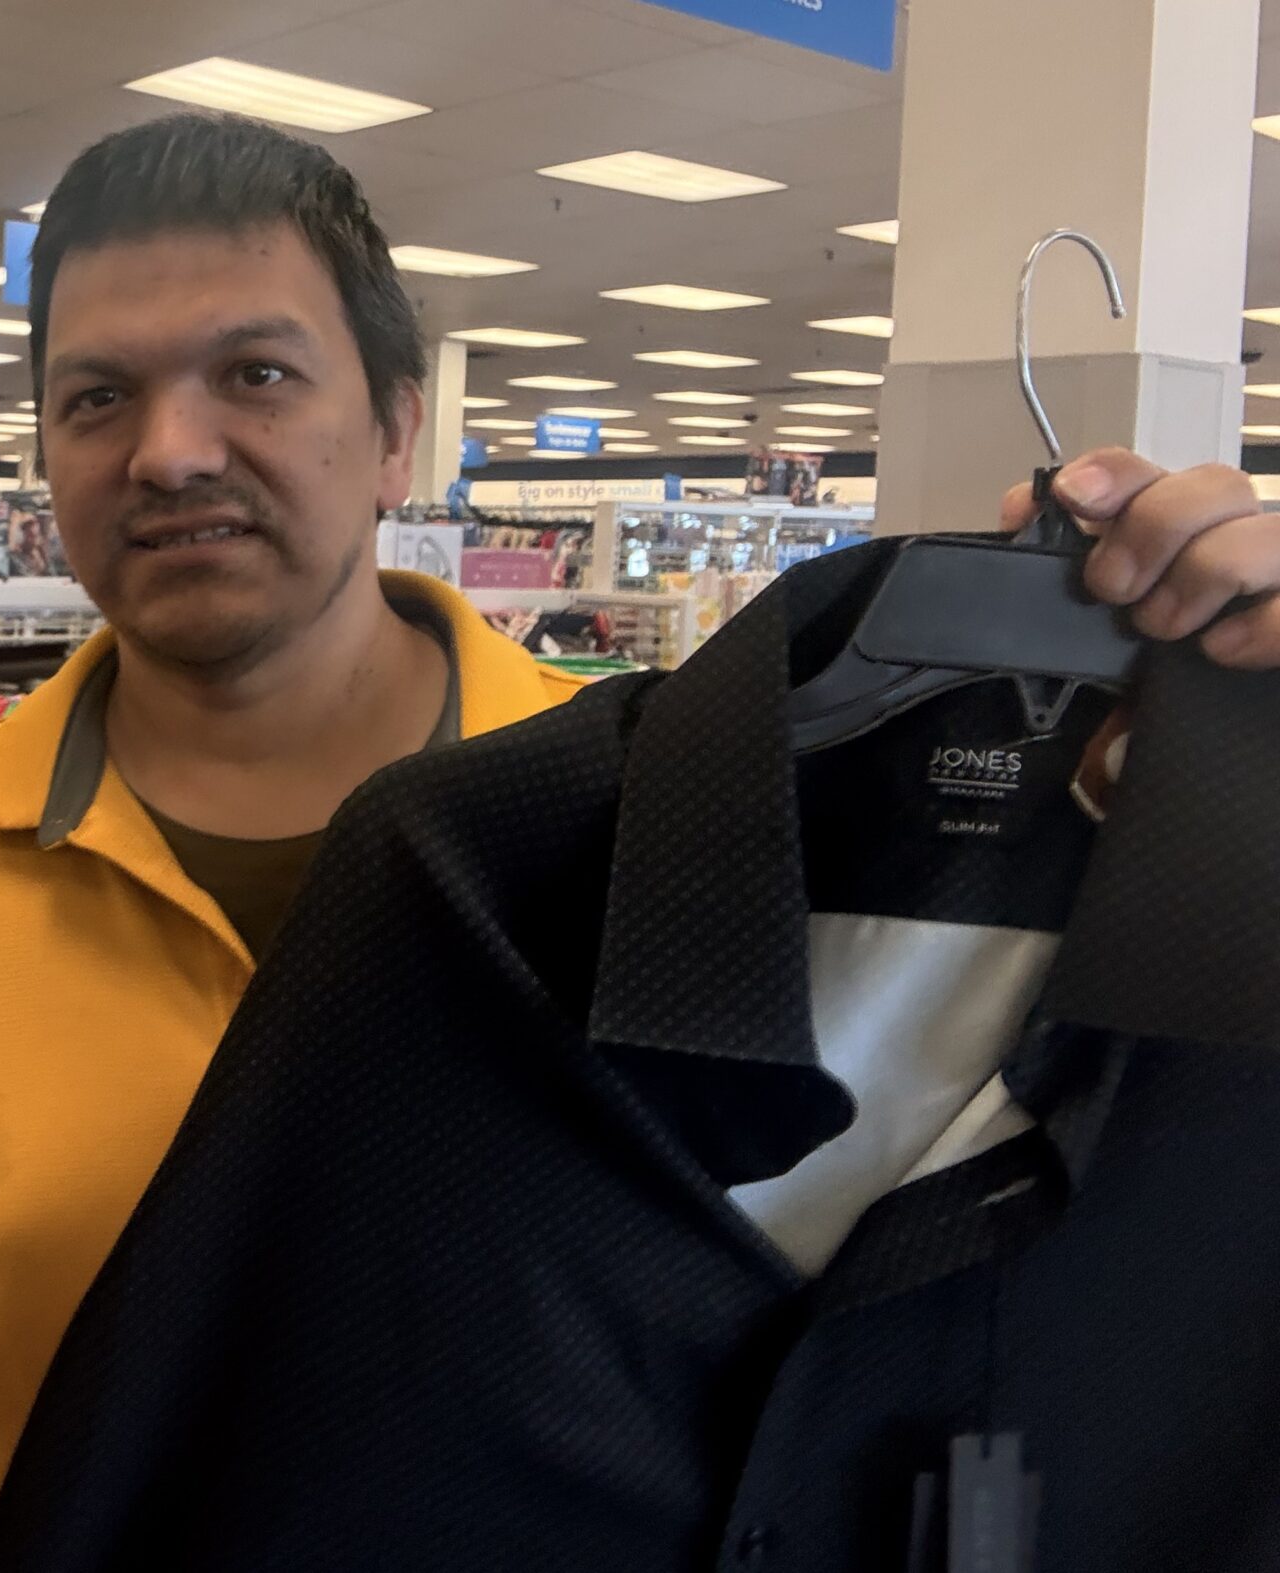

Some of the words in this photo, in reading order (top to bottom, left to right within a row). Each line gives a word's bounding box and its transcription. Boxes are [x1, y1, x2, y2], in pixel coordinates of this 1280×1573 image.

[545, 486, 564, 498] on
[567, 482, 604, 501] style
[929, 746, 1022, 772] JONES
[941, 821, 975, 832] SLIM
